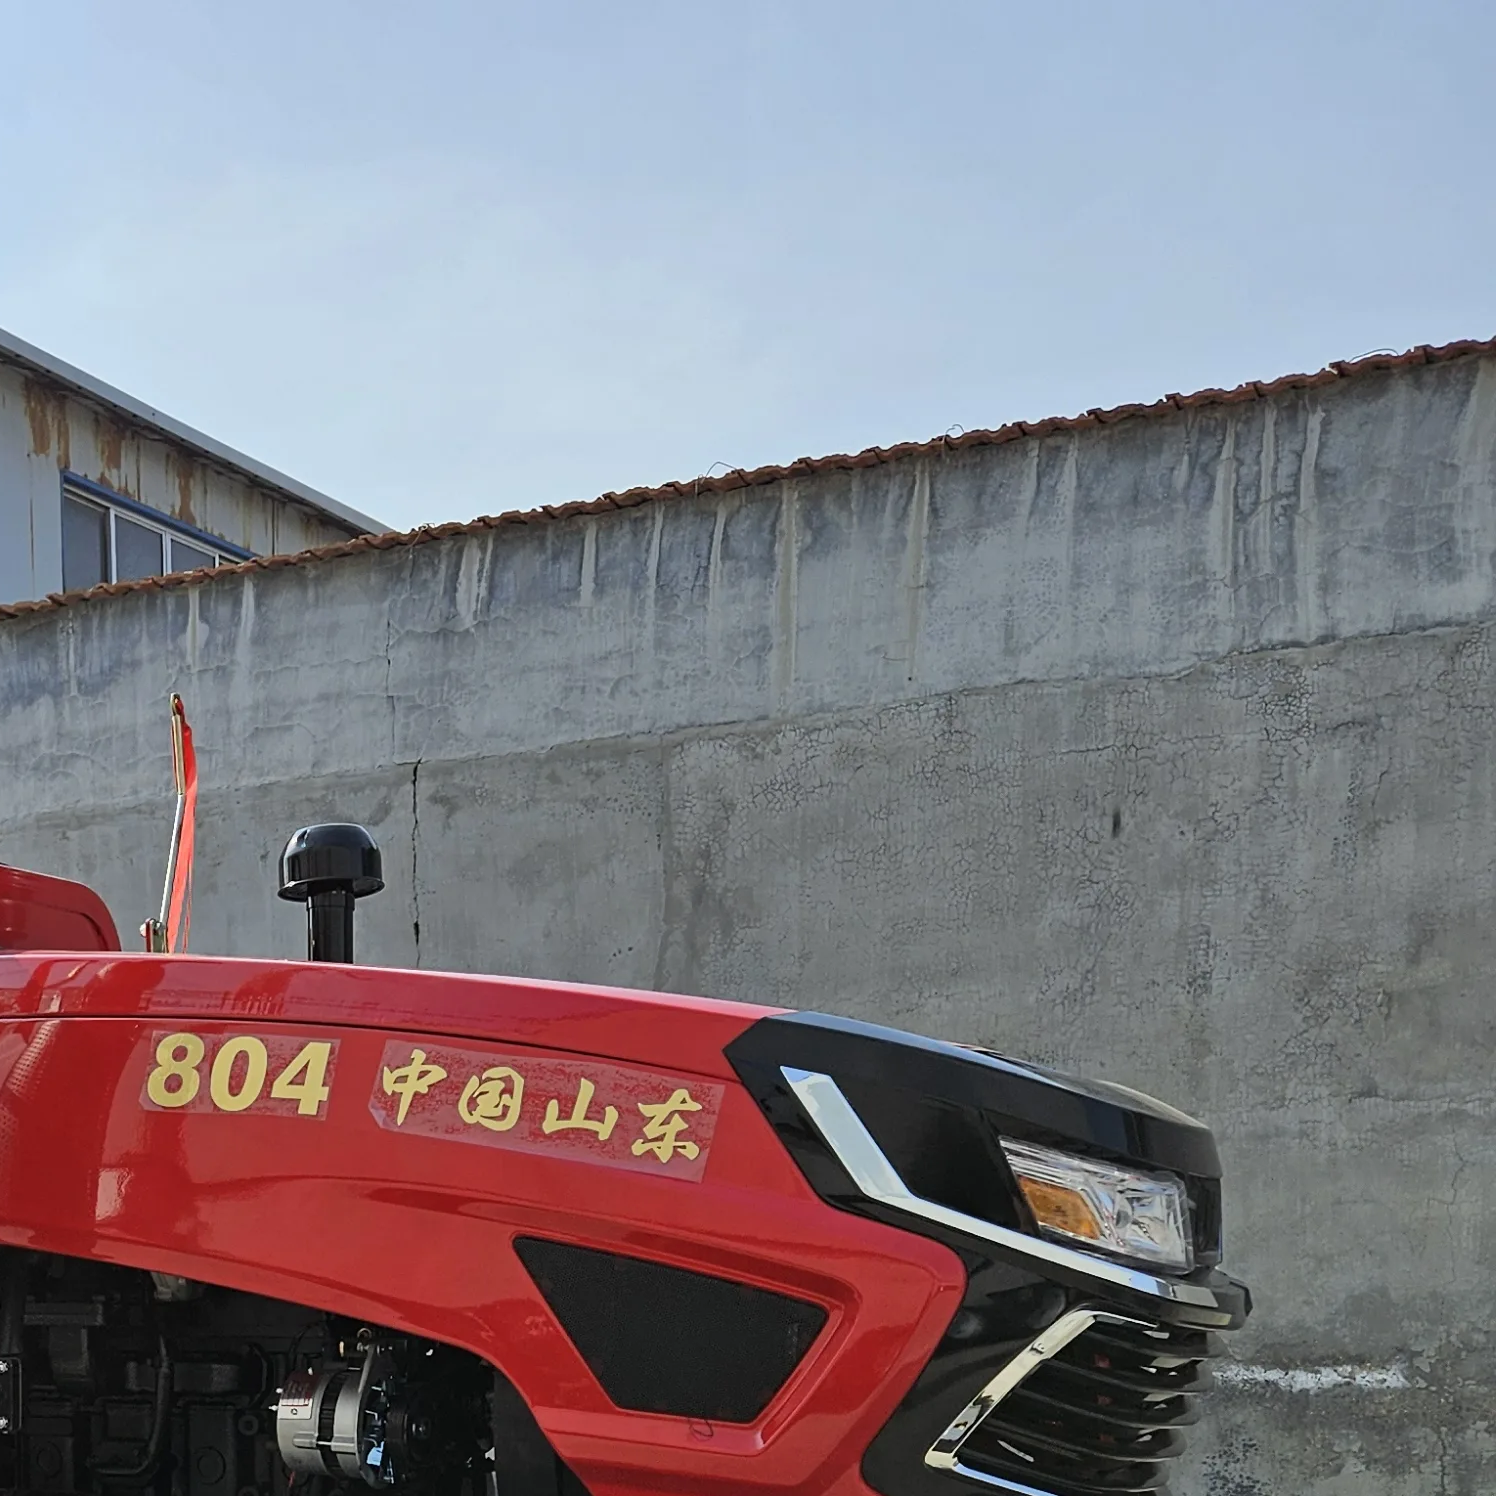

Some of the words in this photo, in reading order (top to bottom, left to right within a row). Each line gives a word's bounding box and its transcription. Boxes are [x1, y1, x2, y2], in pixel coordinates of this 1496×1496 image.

[147, 1033, 332, 1115] 804
[382, 1049, 701, 1163] 中国山东
